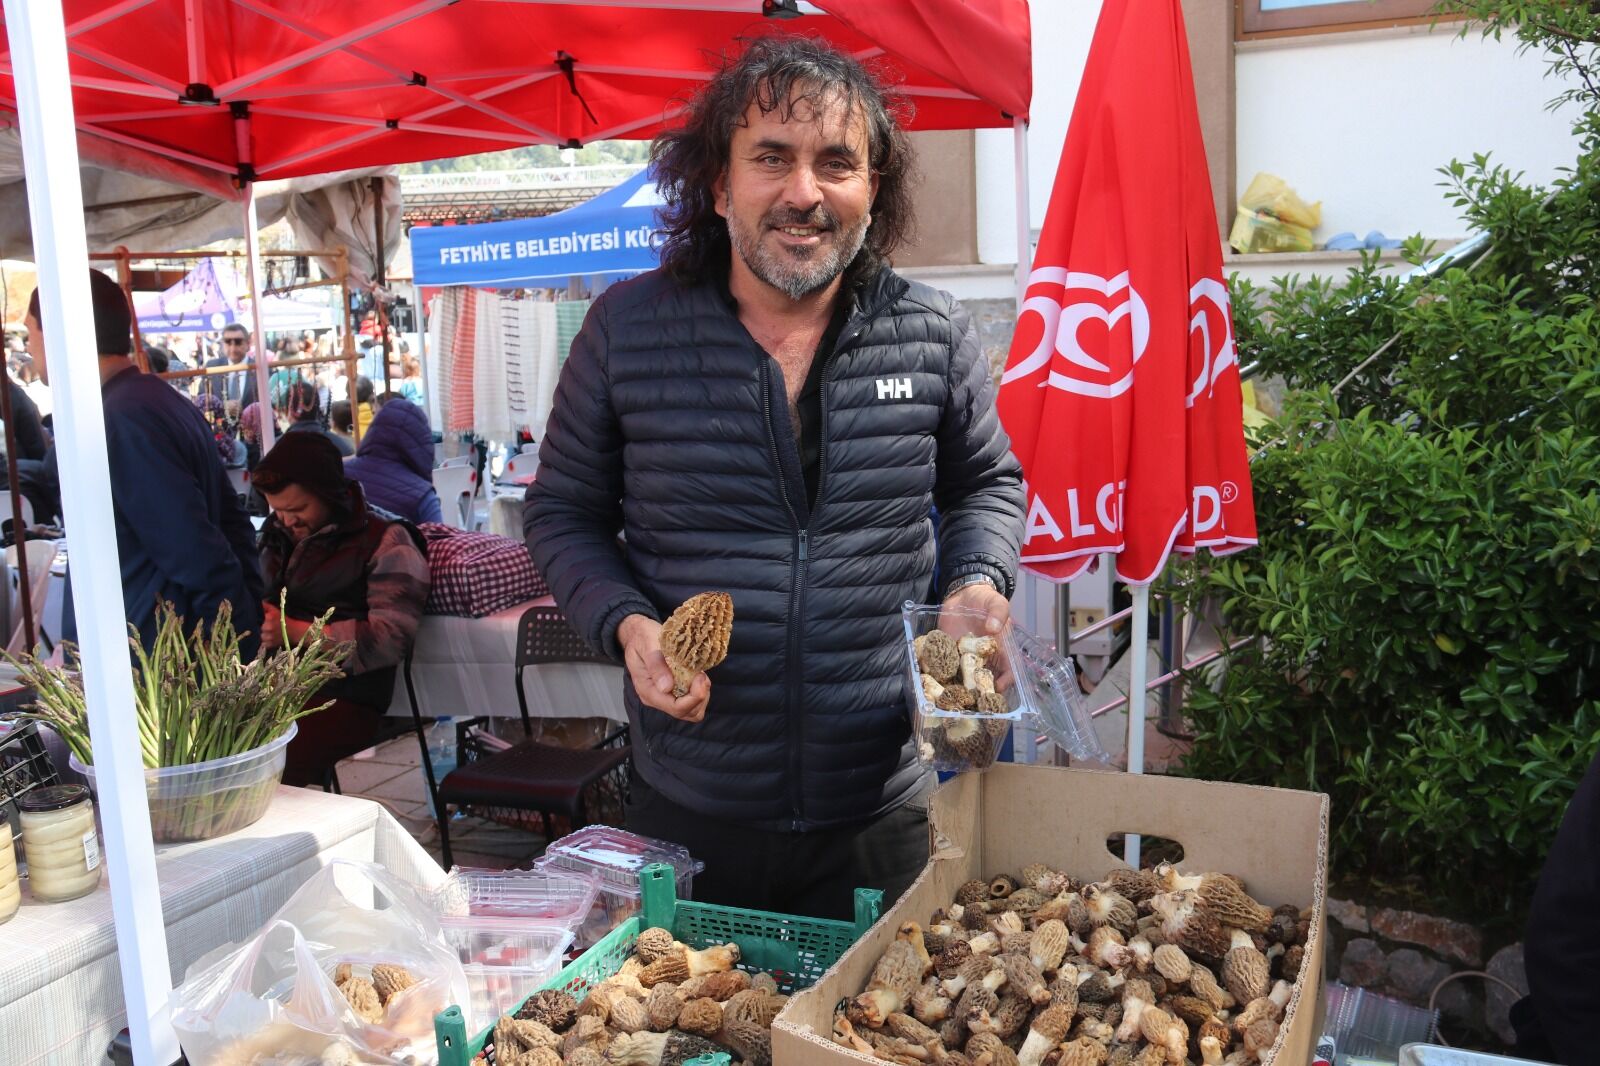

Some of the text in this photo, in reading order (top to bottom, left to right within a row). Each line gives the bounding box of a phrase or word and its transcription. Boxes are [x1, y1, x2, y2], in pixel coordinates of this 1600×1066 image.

[440, 225, 664, 265] FETHİYE BELEDİYESİ KÜL
[876, 378, 912, 400] HH
